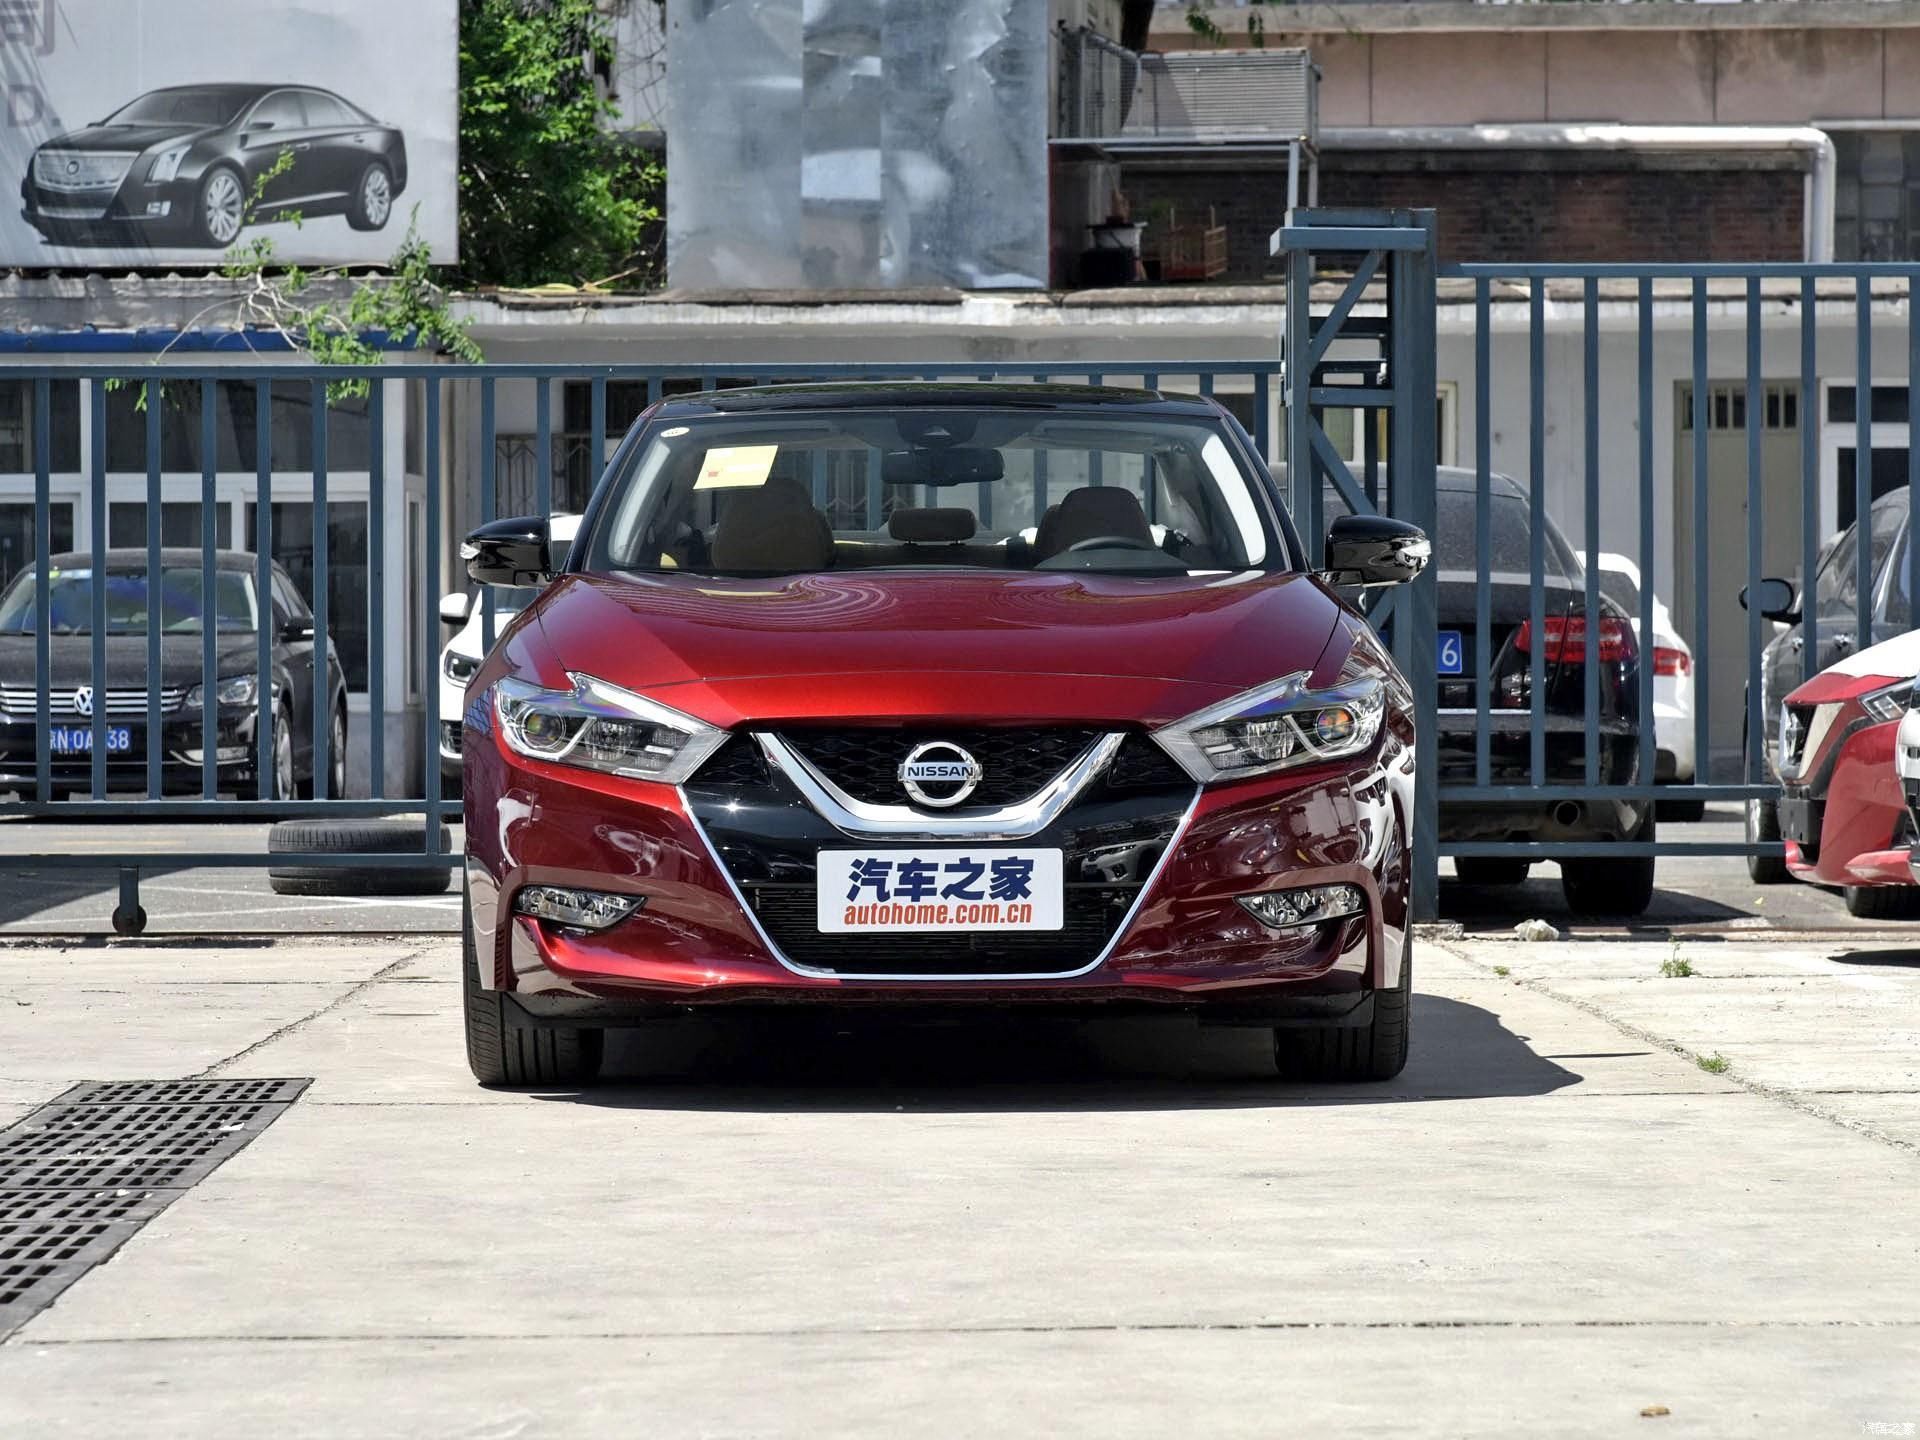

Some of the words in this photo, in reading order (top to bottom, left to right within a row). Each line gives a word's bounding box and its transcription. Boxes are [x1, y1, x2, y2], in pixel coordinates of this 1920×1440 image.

[907, 765, 974, 777] NISSAN
[846, 856, 1034, 902] 汽车之家
[844, 902, 1032, 925] autohome.com.cn
